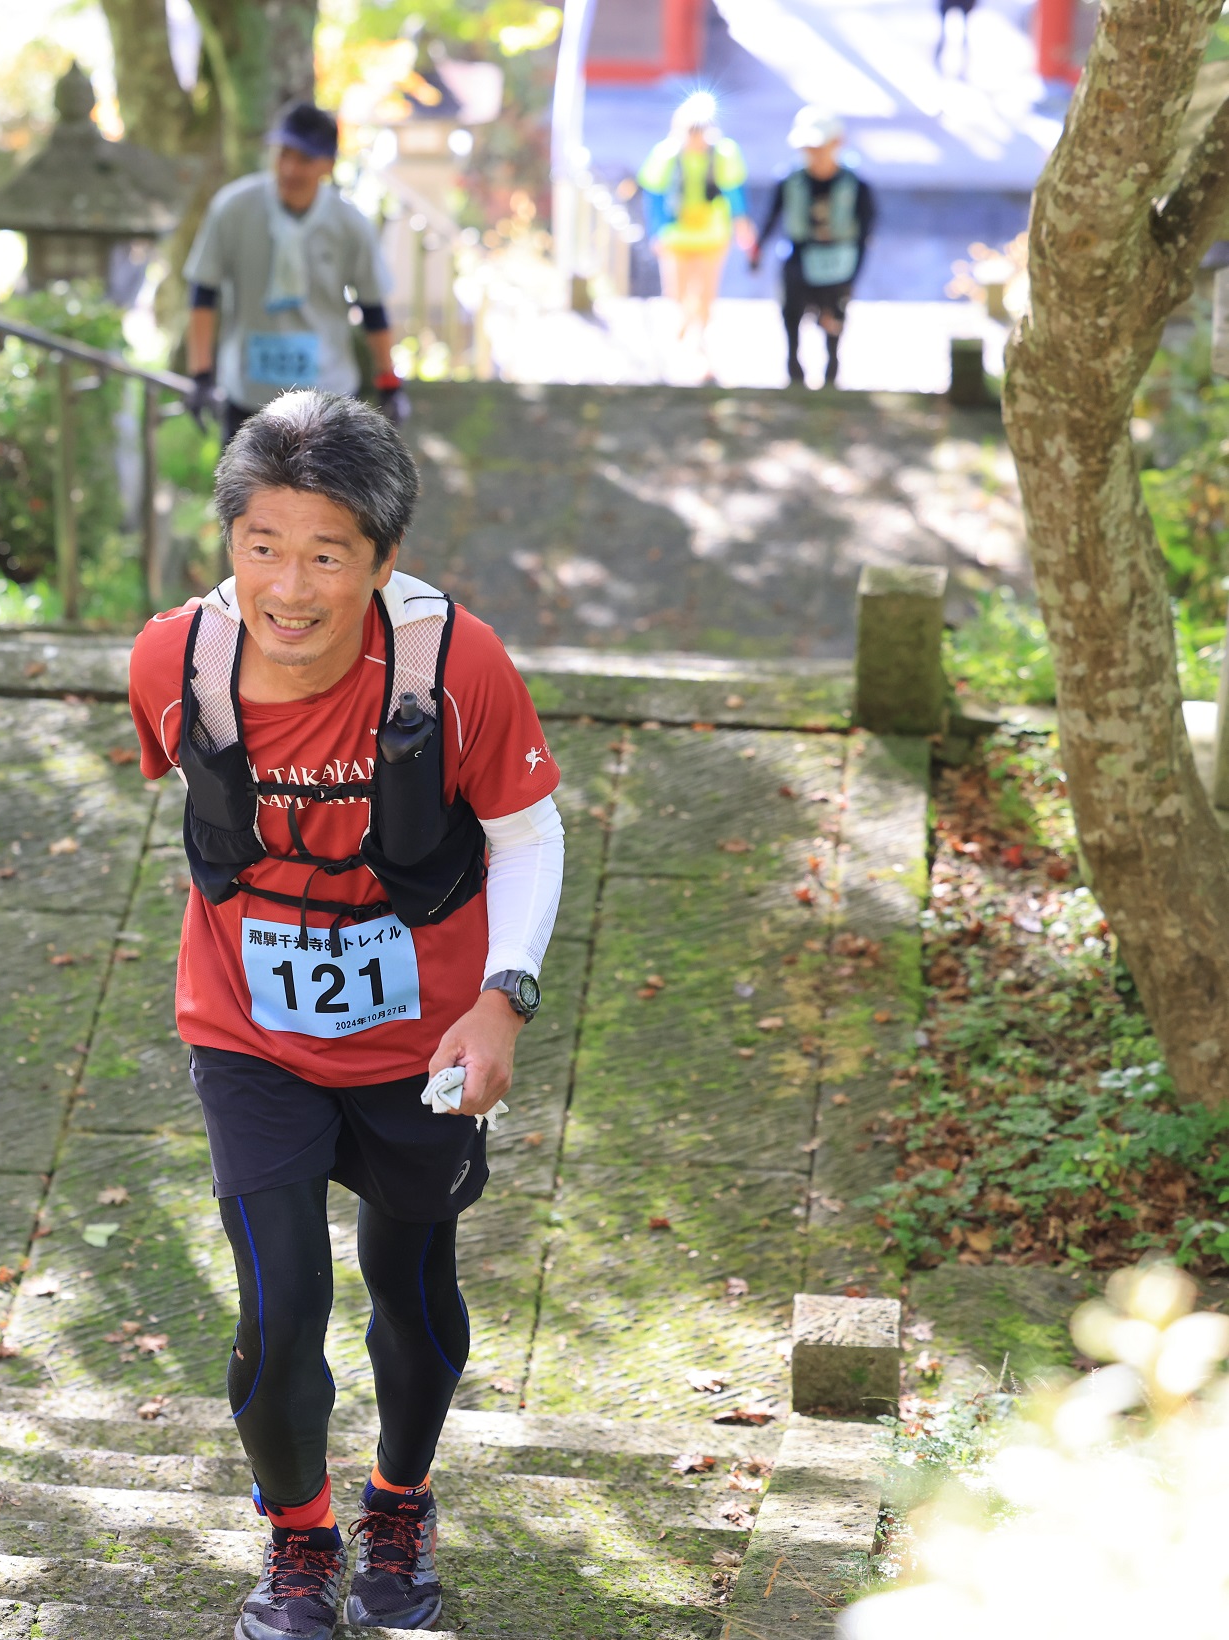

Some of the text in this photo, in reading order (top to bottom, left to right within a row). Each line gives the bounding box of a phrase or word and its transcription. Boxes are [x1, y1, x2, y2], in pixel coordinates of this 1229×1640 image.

[249, 925, 402, 952] 飛騨千寺8トレイル
[272, 957, 384, 1014] 121
[335, 1004, 407, 1030] 2024年10月27日
